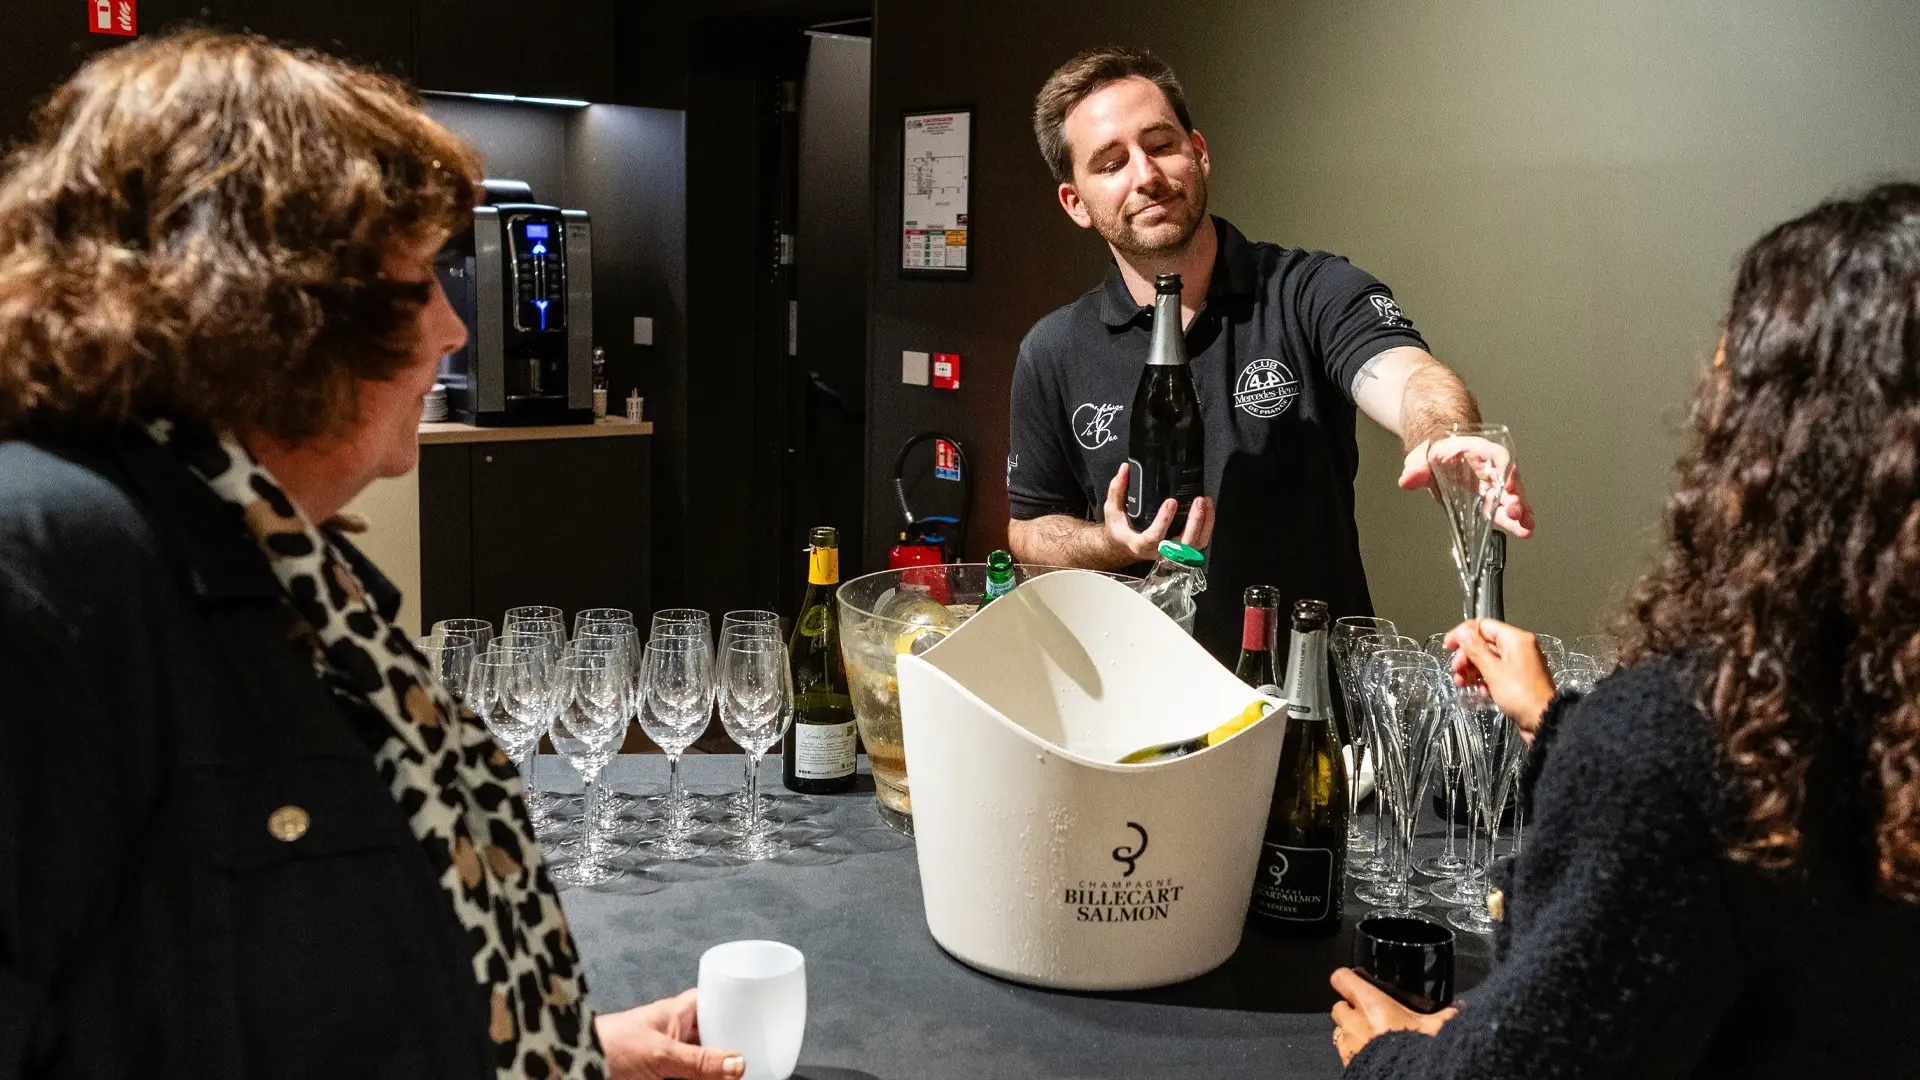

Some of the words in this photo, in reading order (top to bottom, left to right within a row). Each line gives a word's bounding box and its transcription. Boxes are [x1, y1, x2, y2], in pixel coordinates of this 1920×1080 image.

[1246, 360, 1278, 375] CLUB
[1235, 385, 1299, 405] Mercedes-Benz
[1078, 878, 1173, 889] CHAMPAGNE
[1065, 886, 1185, 906] BILLECART
[1077, 904, 1170, 923] SALMON
